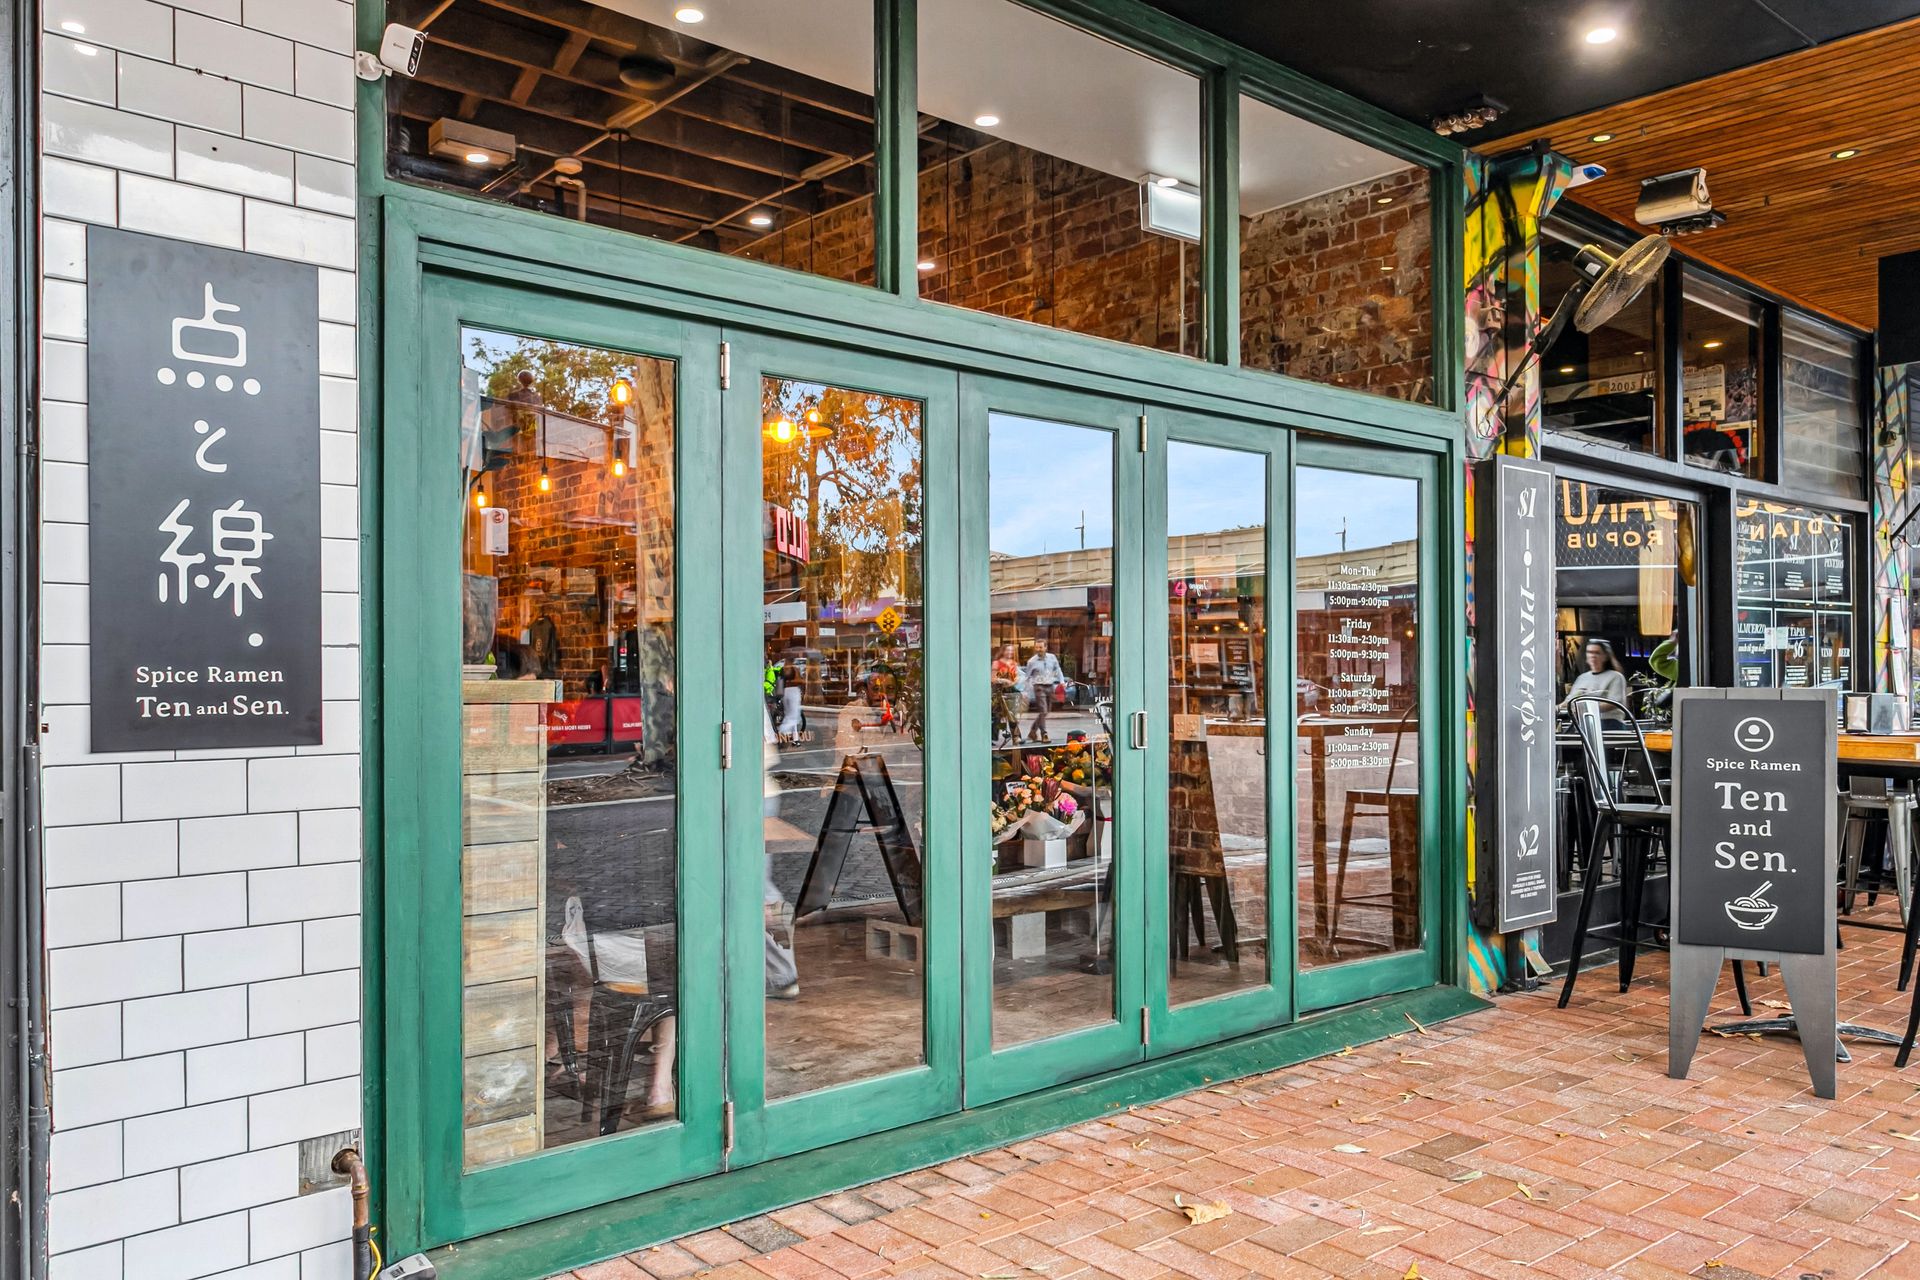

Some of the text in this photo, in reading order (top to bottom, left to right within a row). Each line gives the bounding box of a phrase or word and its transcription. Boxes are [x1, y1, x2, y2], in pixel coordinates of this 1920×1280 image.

[1517, 487, 1537, 520] $1
[1340, 565, 1377, 576] Mon-Thu
[1328, 581, 1389, 594] 11:30am-2:30pm
[1329, 596, 1390, 608] 5:00pm-9:00pm
[1346, 618, 1372, 631] Friday
[1328, 634, 1389, 647] 11:30am-2:30pm
[1330, 649, 1390, 661] 5:00pm-9:30pm
[1793, 640, 1804, 659] $6
[136, 666, 284, 687] Spice Ramen
[1340, 672, 1377, 684] Saturday
[1327, 688, 1389, 699] 11:00am-2:30pm
[136, 695, 290, 718] Ten and Sen.
[1329, 703, 1390, 715] 5:00pm-9:30pm
[1344, 726, 1374, 738] Sunday
[1327, 742, 1389, 753] 11:00am-2:30pm
[1330, 756, 1391, 769] 5:00pm-8:30pm
[1706, 757, 1802, 772] Spice Ramen
[1714, 781, 1788, 812] Ten
[1728, 819, 1773, 837] and
[1517, 824, 1540, 861] $2
[1714, 841, 1798, 874] Sen.
